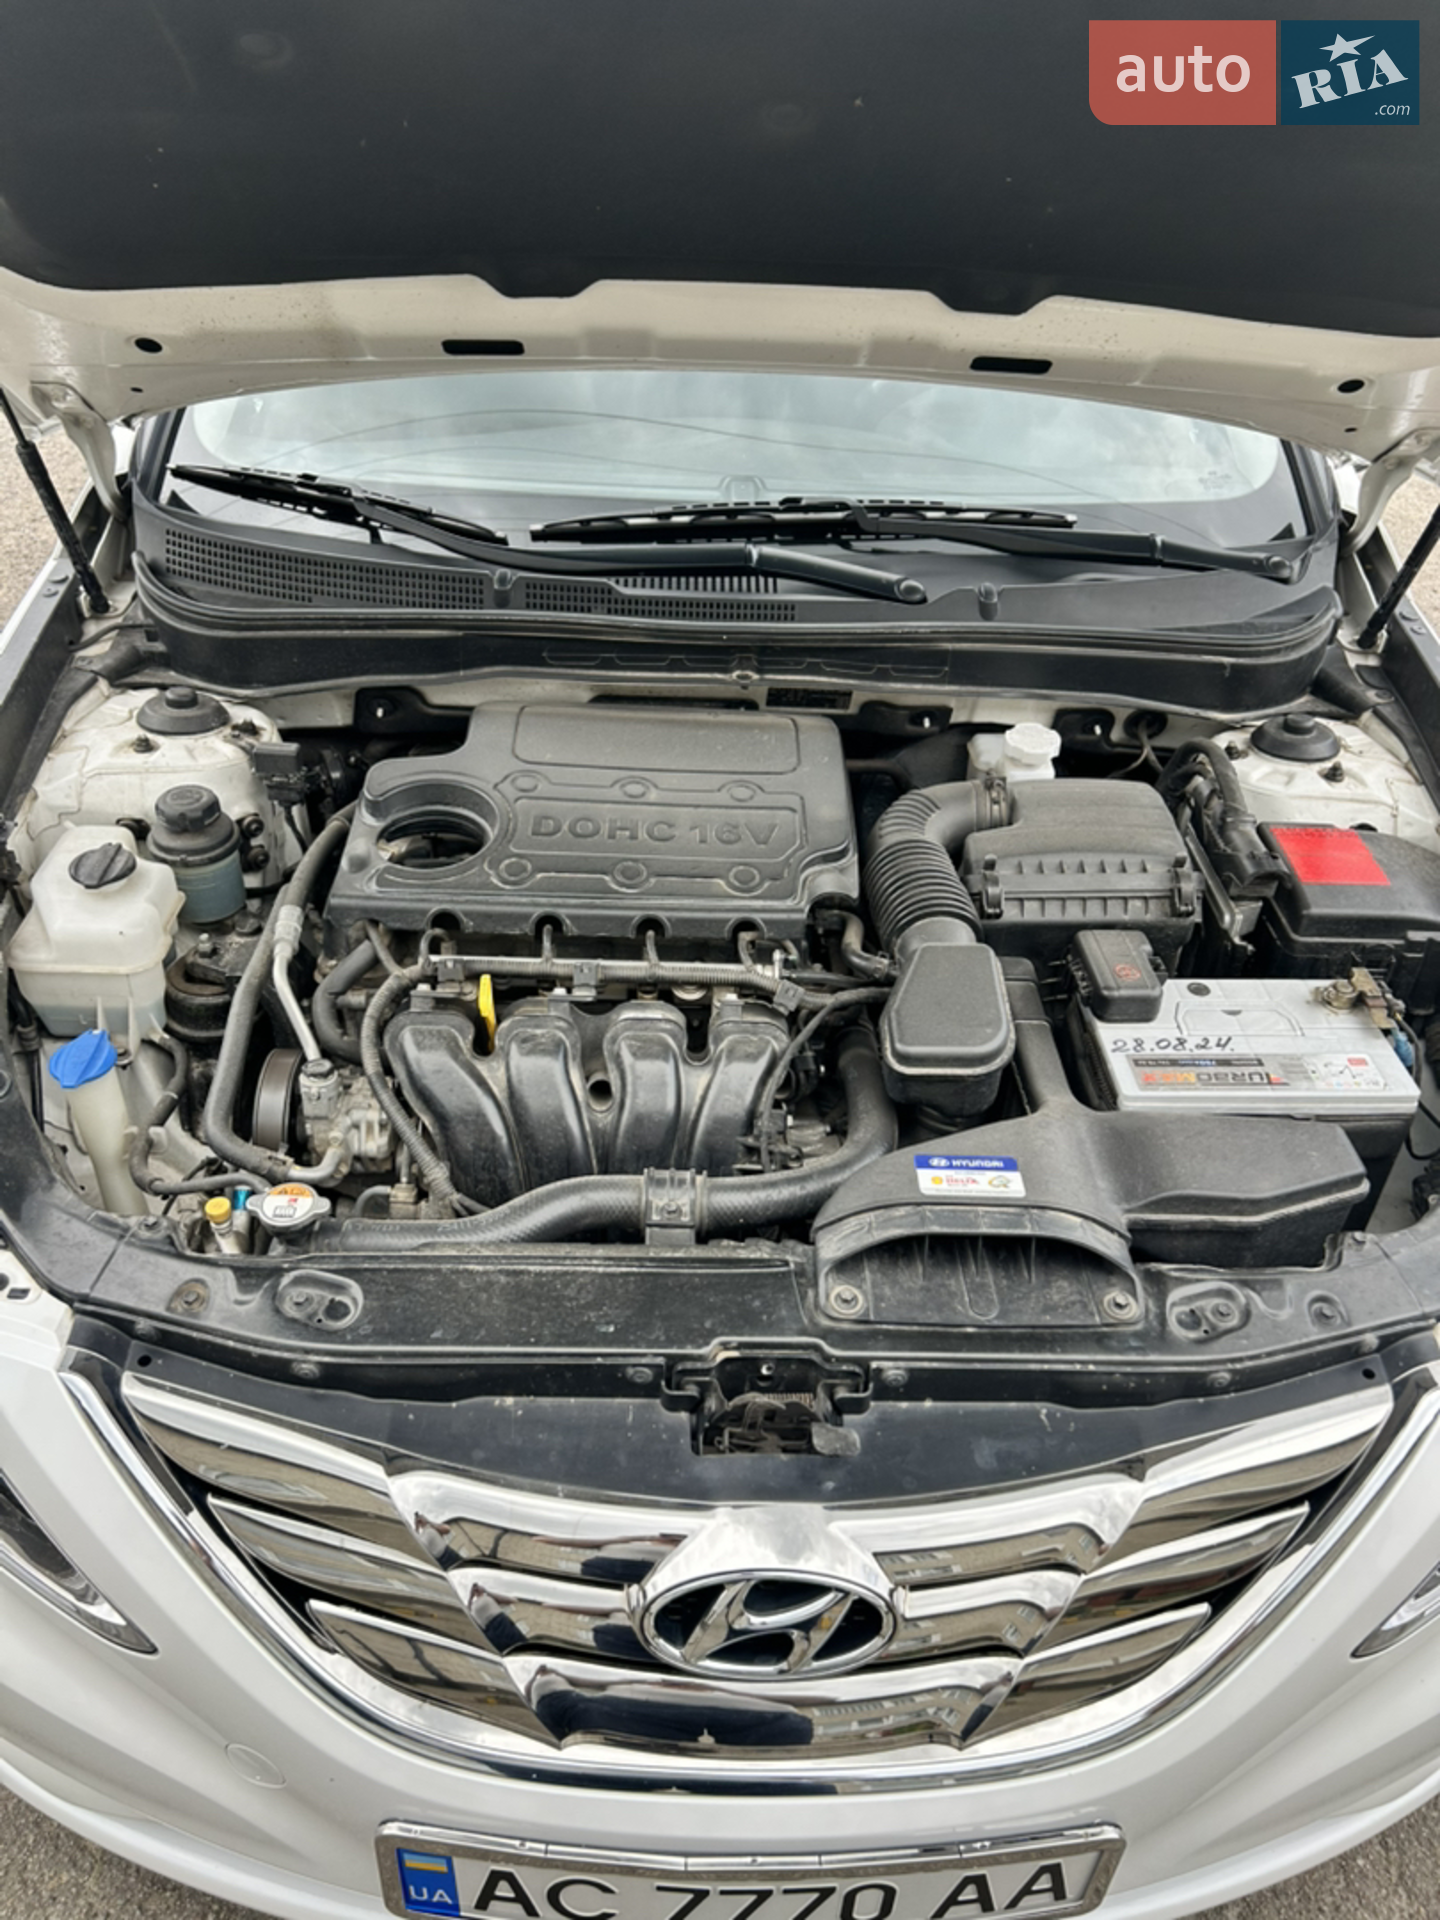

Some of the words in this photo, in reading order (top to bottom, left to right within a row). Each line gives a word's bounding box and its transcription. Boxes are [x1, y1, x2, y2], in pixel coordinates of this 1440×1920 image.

[530, 814, 677, 843] DOHC
[690, 822, 779, 846] 16V
[951, 1159, 1005, 1168] HYUNDAI
[409, 1886, 454, 1904] UA
[473, 1868, 618, 1920] AC
[655, 1882, 898, 1920] 7770
[929, 1861, 1068, 1920] AA
